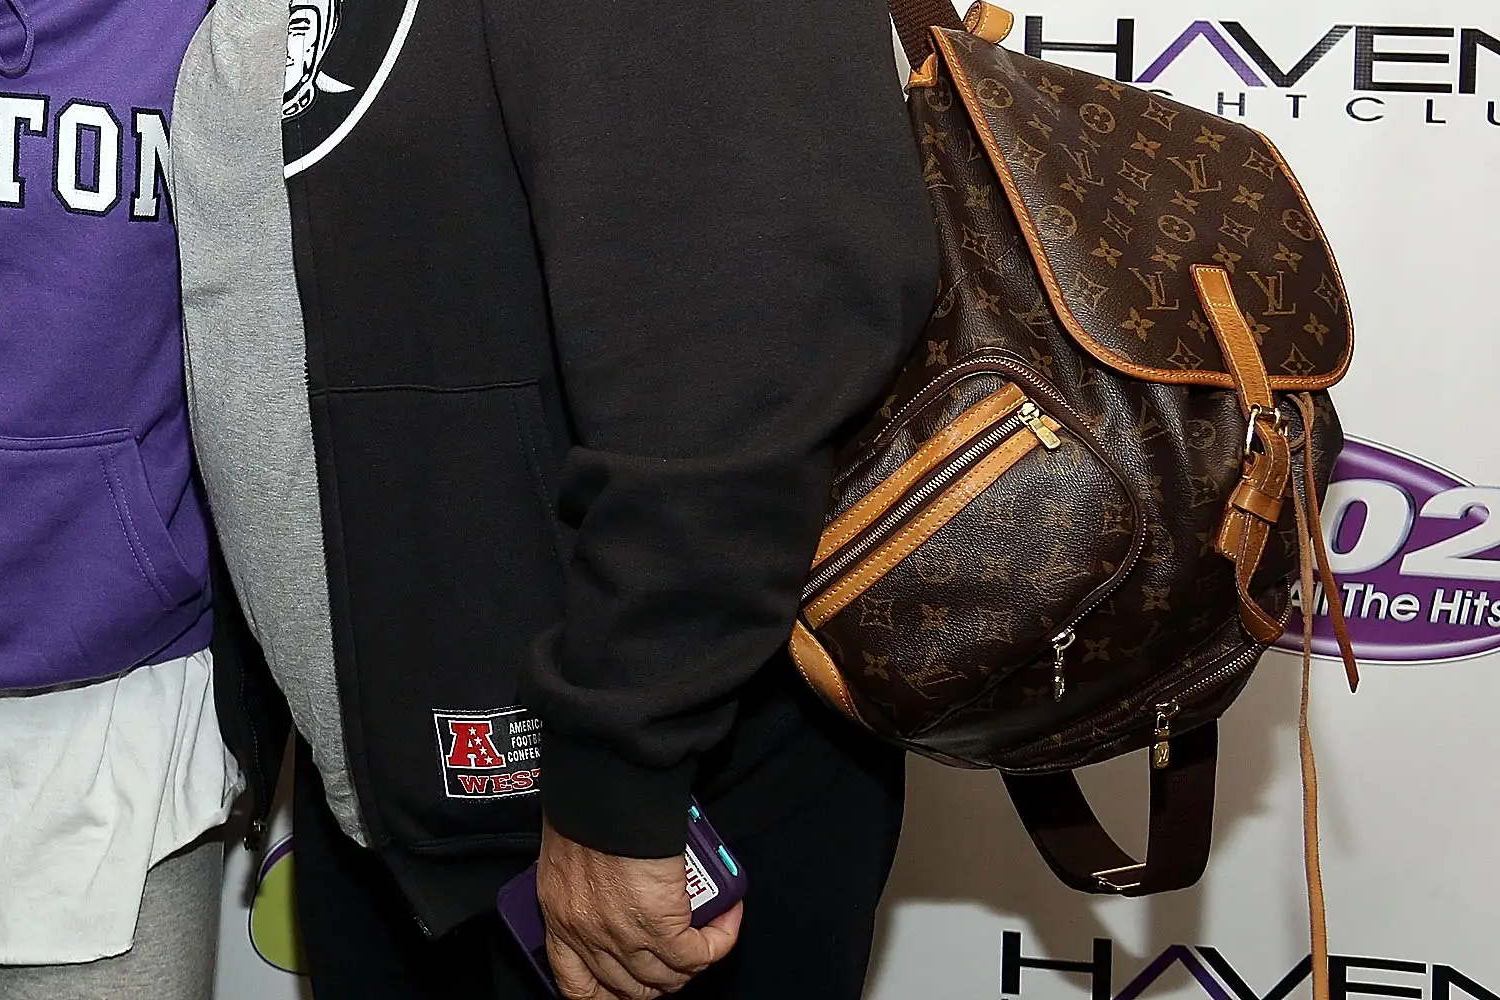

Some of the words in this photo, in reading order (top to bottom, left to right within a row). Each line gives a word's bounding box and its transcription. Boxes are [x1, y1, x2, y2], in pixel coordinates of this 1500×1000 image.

[1147, 89, 1500, 126] HTCL
[1312, 478, 1500, 581] 02
[1342, 582, 1420, 622] The
[509, 718, 543, 735] AMERIC
